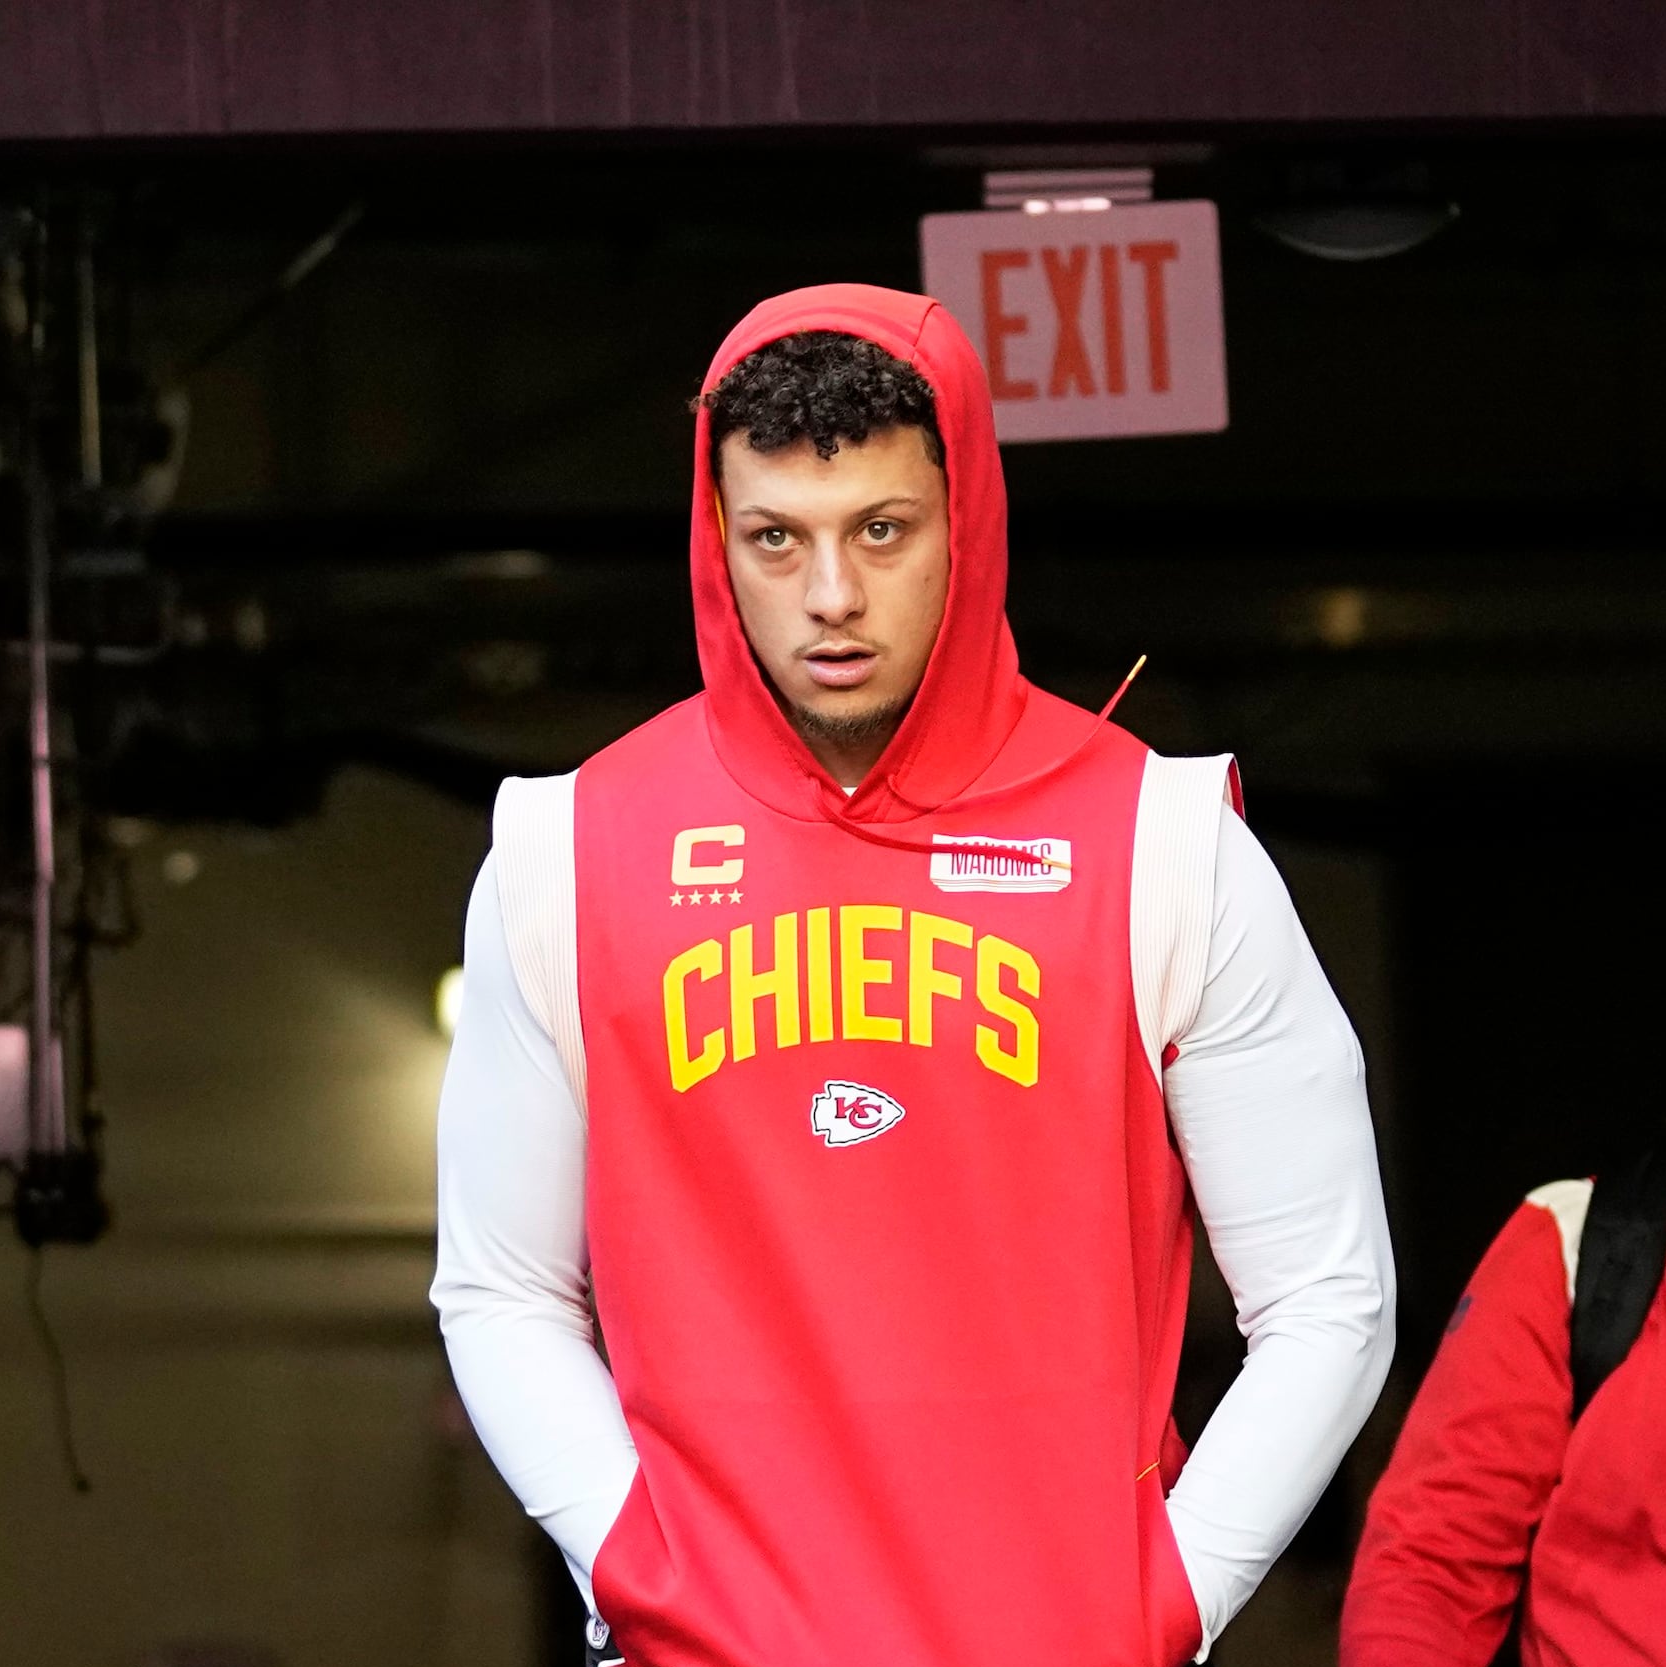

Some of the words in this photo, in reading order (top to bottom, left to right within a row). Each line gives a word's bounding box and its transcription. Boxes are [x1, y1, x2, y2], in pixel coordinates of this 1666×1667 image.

[980, 242, 1178, 401] EXIT
[671, 824, 745, 886] C
[663, 904, 1041, 1093] CHIEFS
[834, 1096, 882, 1130] KC
